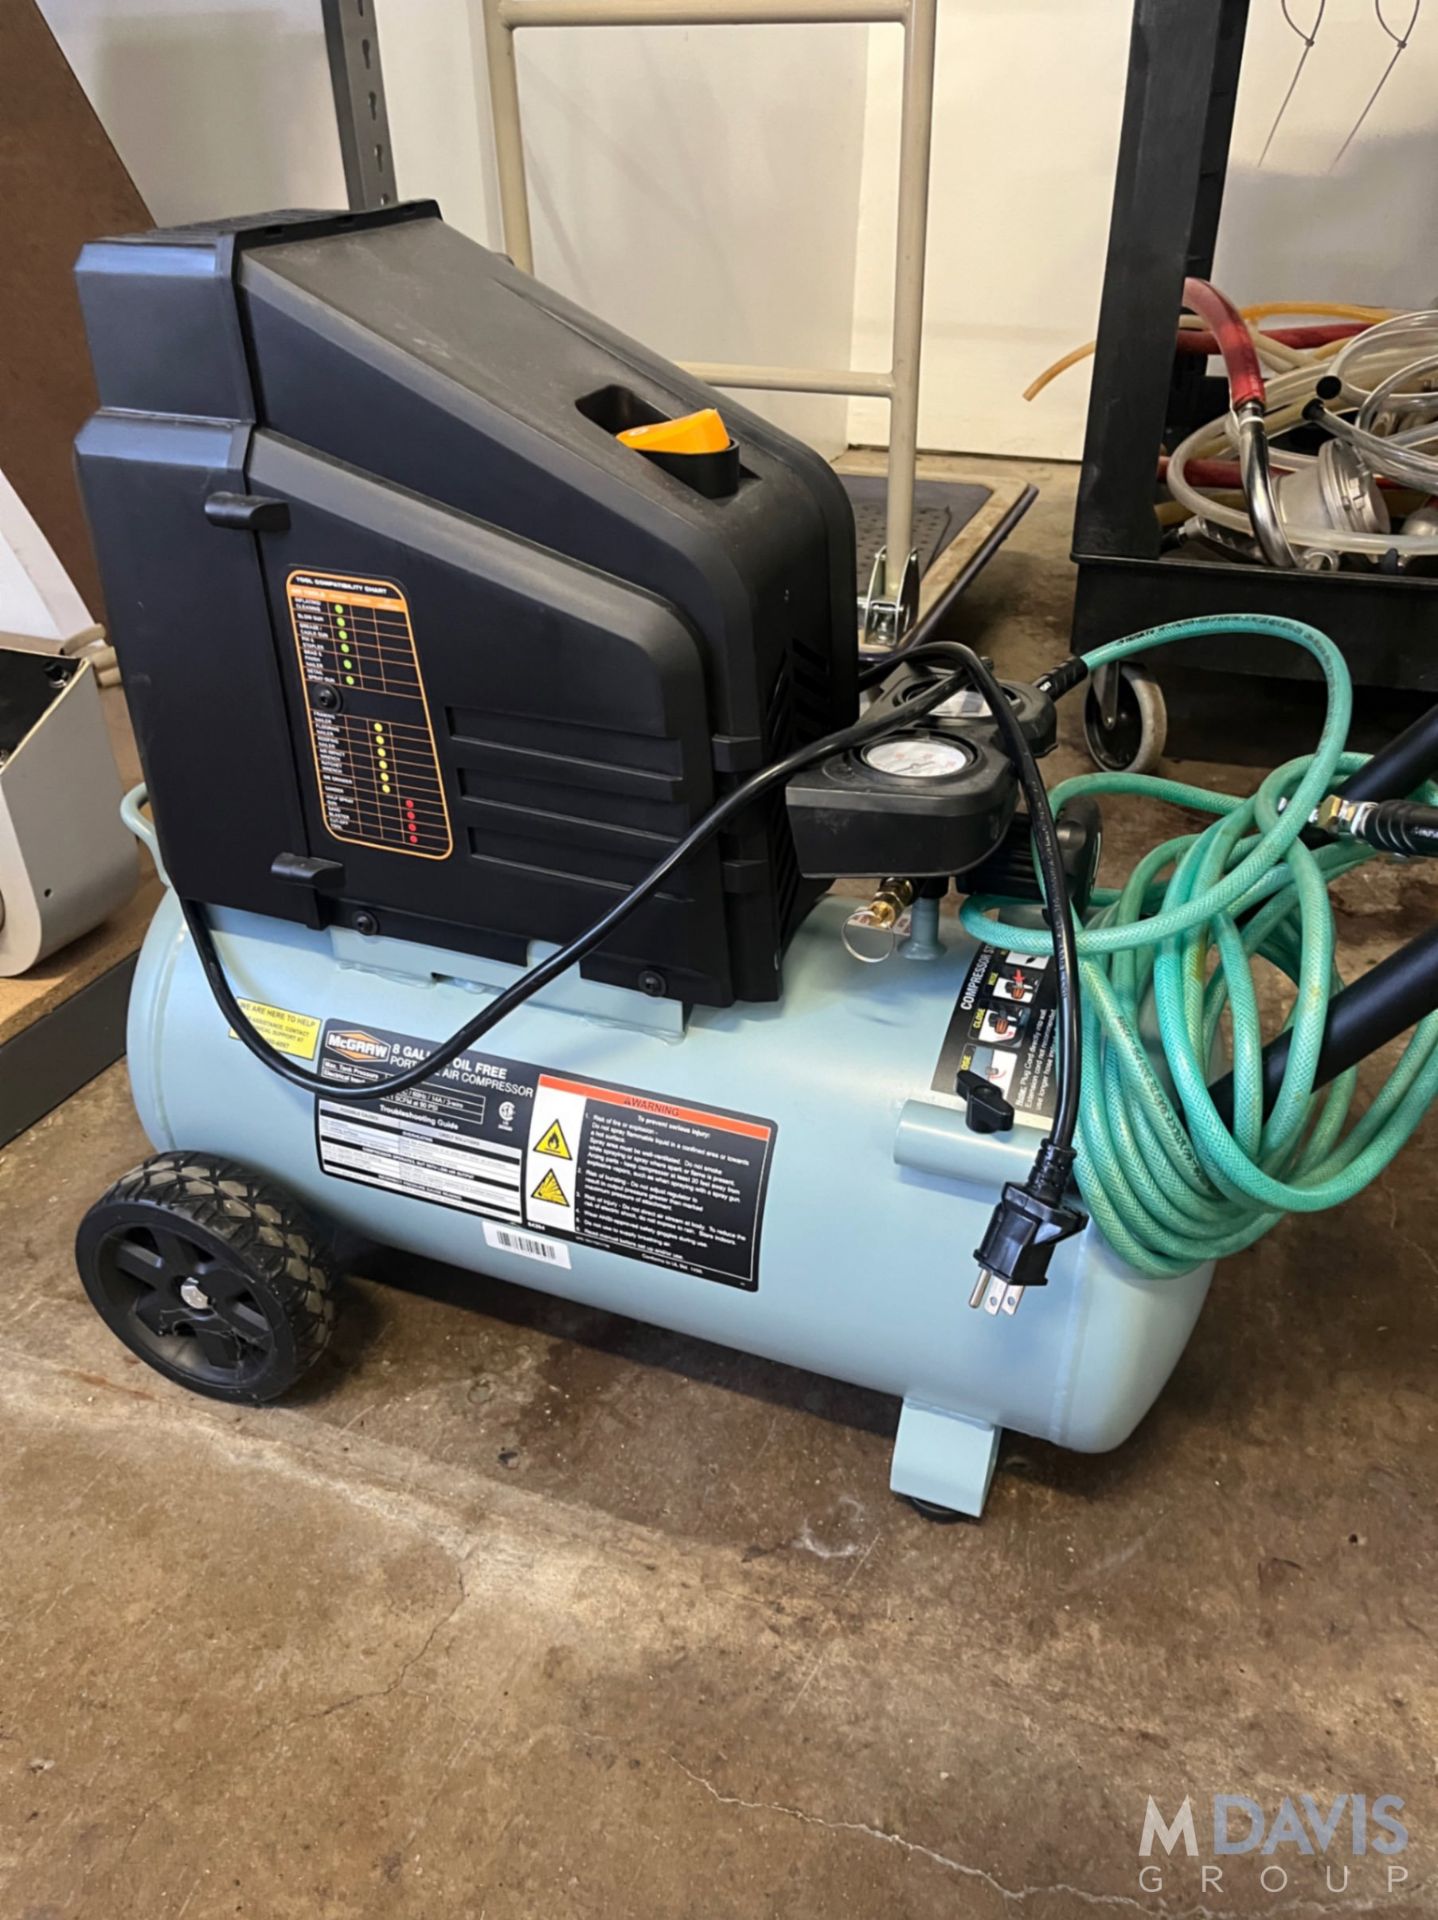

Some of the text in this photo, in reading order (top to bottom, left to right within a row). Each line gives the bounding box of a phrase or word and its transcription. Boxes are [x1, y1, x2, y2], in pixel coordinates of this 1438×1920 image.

[960, 952, 991, 1010] COMPRESSOR
[328, 1033, 388, 1058] McGRAW
[392, 1043, 400, 1054] 8
[452, 1057, 472, 1072] OIL
[475, 1062, 508, 1080] FREE
[441, 1068, 460, 1080] AIR
[461, 1072, 534, 1098] COMPRESSOR
[380, 1104, 436, 1126] Troubleshooting
[437, 1119, 459, 1130] Guide
[631, 1098, 680, 1116] WARNING
